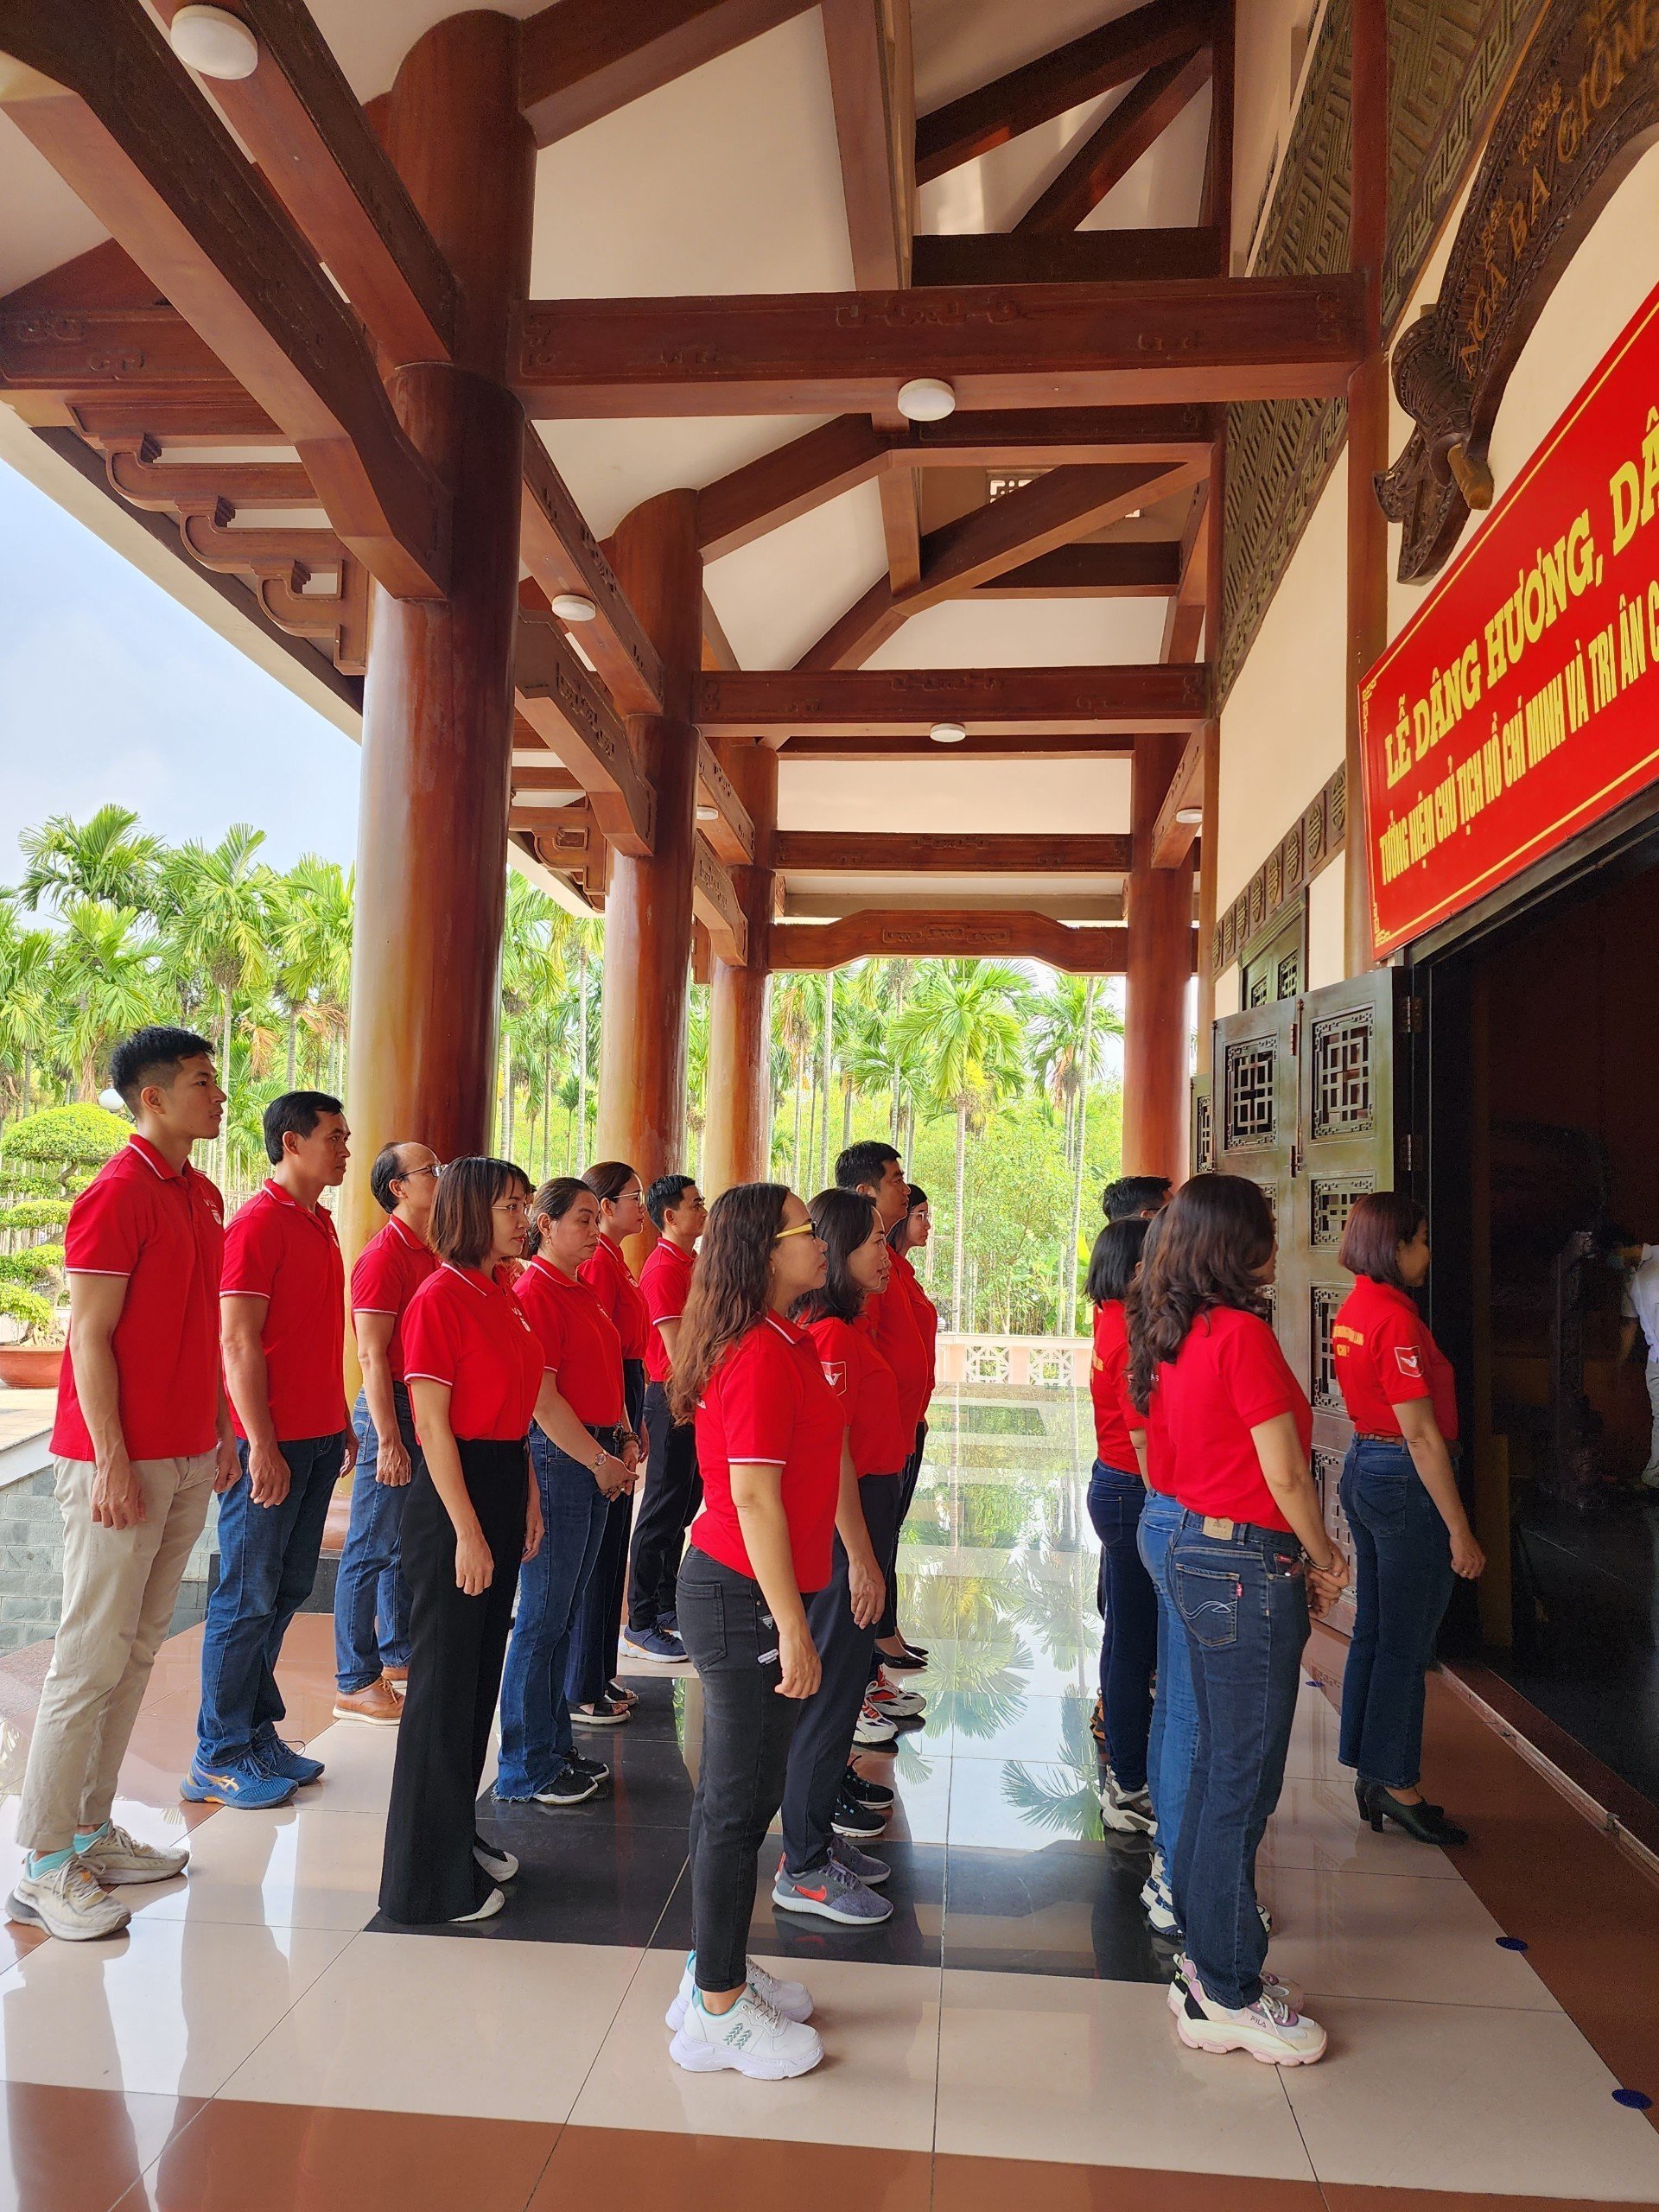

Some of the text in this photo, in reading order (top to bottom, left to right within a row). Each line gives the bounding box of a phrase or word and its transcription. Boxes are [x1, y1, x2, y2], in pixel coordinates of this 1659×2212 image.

[1379, 810, 1410, 886] TƯỞNG
[1408, 790, 1436, 868] NIỆM
[1434, 755, 1458, 843] CHỦ
[1456, 749, 1484, 836] TỊCH
[1483, 711, 1503, 804] HỒ
[1502, 696, 1527, 788] CHÍ
[1525, 672, 1567, 769] MINH
[1565, 639, 1590, 734] VÀ
[1588, 623, 1618, 714] TRI
[1619, 594, 1647, 690] ÂN
[1384, 694, 1412, 790] LỄ
[1413, 639, 1482, 762] DÂNG
[1484, 508, 1604, 690] HƯƠNG,
[1250, 2015, 1267, 2028] FILA
